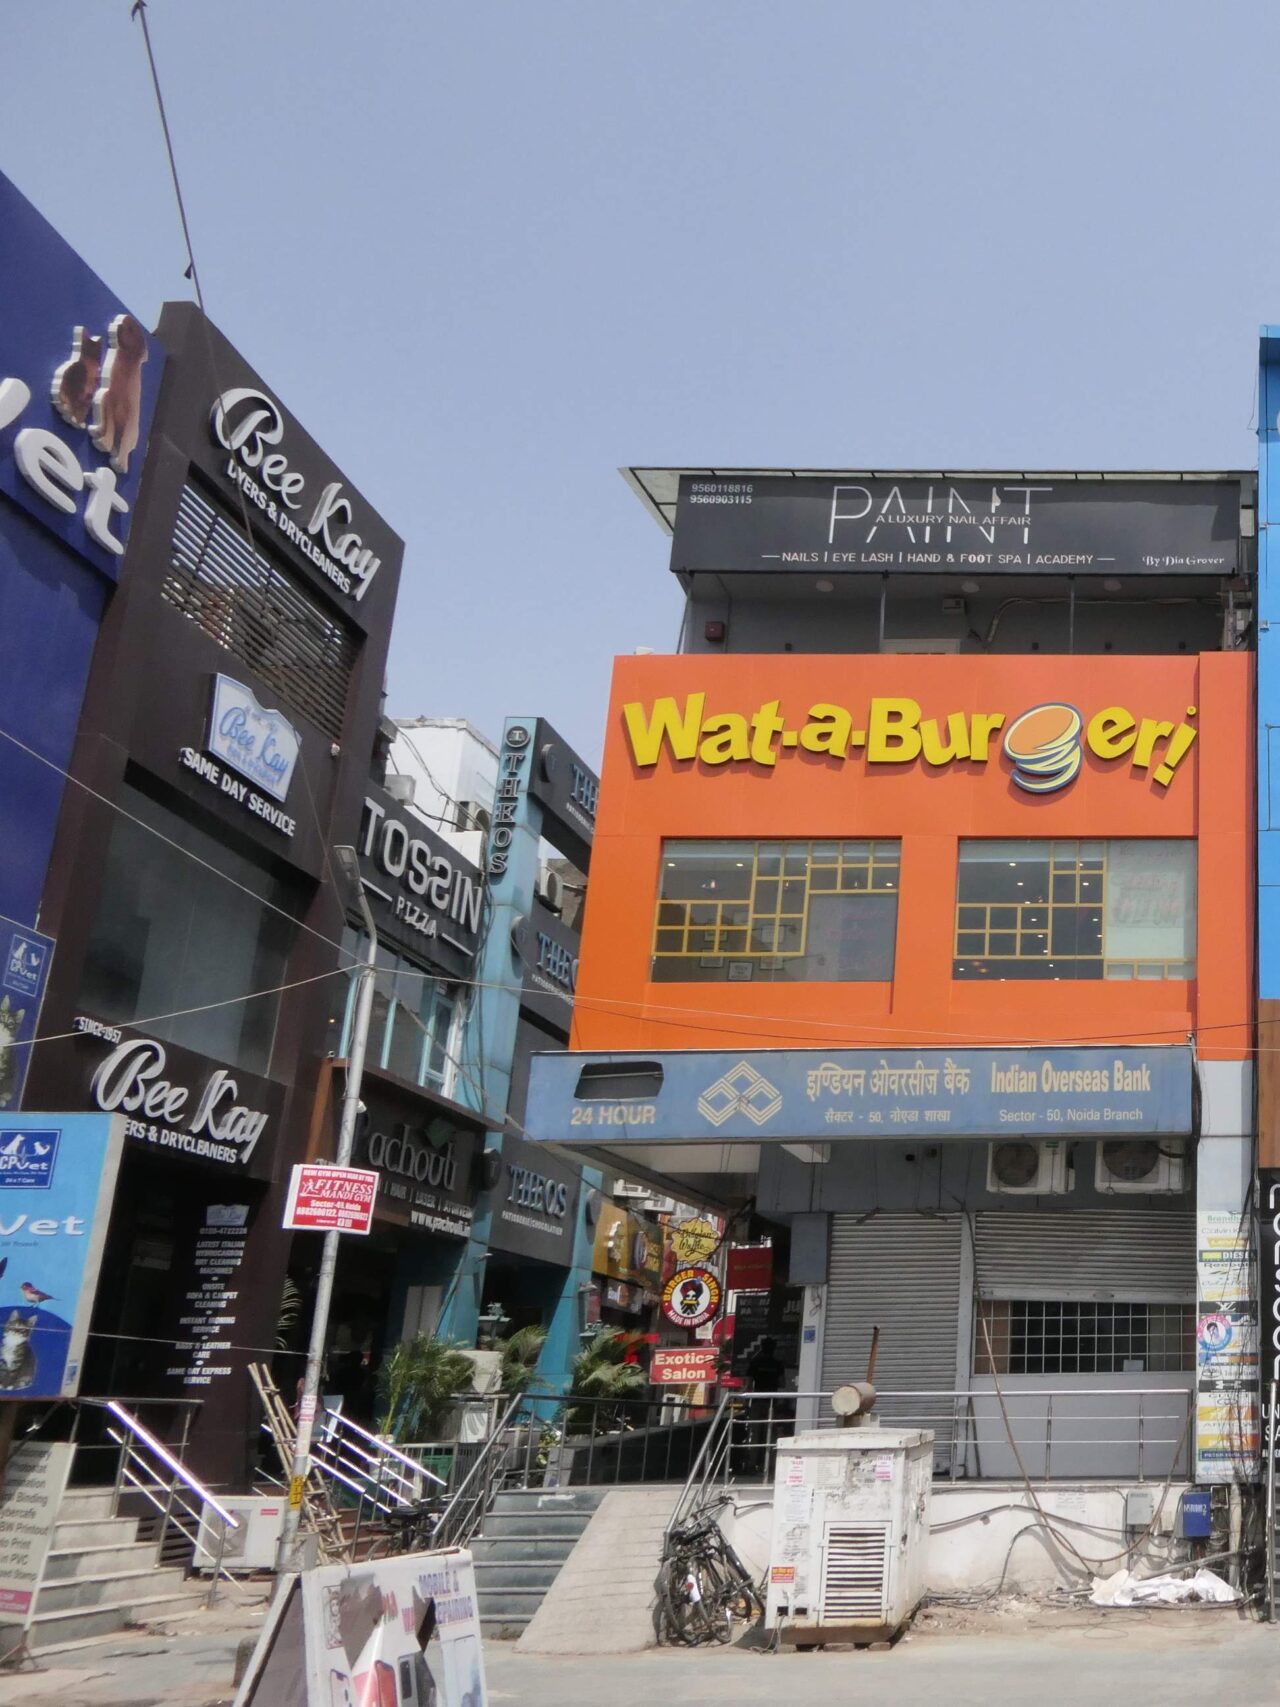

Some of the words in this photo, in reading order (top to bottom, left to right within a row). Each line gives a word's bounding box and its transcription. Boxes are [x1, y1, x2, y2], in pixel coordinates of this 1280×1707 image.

[210, 388, 305, 510] Bee
[309, 483, 381, 601] Kay
[690, 495, 752, 505] 9560903115
[227, 459, 268, 510] DYERS
[268, 502, 279, 521] &
[279, 514, 351, 595] DRYCLEANERS
[829, 486, 1053, 544] PAINT
[876, 515, 885, 523] A
[888, 515, 944, 523] LUXURY
[949, 515, 979, 525] NAIL
[983, 516, 1031, 526] AFFAIR
[782, 552, 819, 562] NAILS
[832, 552, 857, 563] EYE
[861, 553, 894, 563] LASH
[907, 553, 941, 563] HAND
[946, 553, 955, 563] &
[960, 553, 993, 564] FOOT
[998, 554, 1022, 564] SPA
[1035, 554, 1094, 565] ACADEMY
[182, 748, 220, 786] SAME
[222, 772, 249, 801] DAY
[249, 791, 297, 837] SERVICE
[488, 753, 524, 875] THEOS
[396, 896, 438, 940] PIZZA
[806, 1062, 866, 1101] इण्डियन
[943, 1057, 971, 1096] बैंक
[991, 1060, 1037, 1093] Indian
[1041, 1060, 1109, 1093] Overseas
[1114, 1060, 1151, 1093] Bank
[91, 1038, 189, 1122] Bee
[191, 1070, 269, 1164] Kay
[571, 1106, 593, 1125] 24
[599, 1105, 656, 1125] HOUR
[1000, 1109, 1036, 1122] Sector
[1067, 1108, 1100, 1121] Noida
[1104, 1107, 1143, 1121] Branch
[125, 1119, 146, 1140] ERS
[147, 1126, 158, 1143] &
[161, 1129, 239, 1164] DRYCLEANERS
[315, 1179, 374, 1194] FITNESS
[320, 1189, 354, 1201] MANDI
[354, 1194, 372, 1203] GYM
[506, 1163, 568, 1220] THEOS
[663, 1269, 695, 1303] BURGER
[703, 1273, 720, 1304] SINGH
[667, 1309, 684, 1325] MADE
[662, 1368, 706, 1380] Salon
[436, 1596, 474, 1625] EPAIRING
